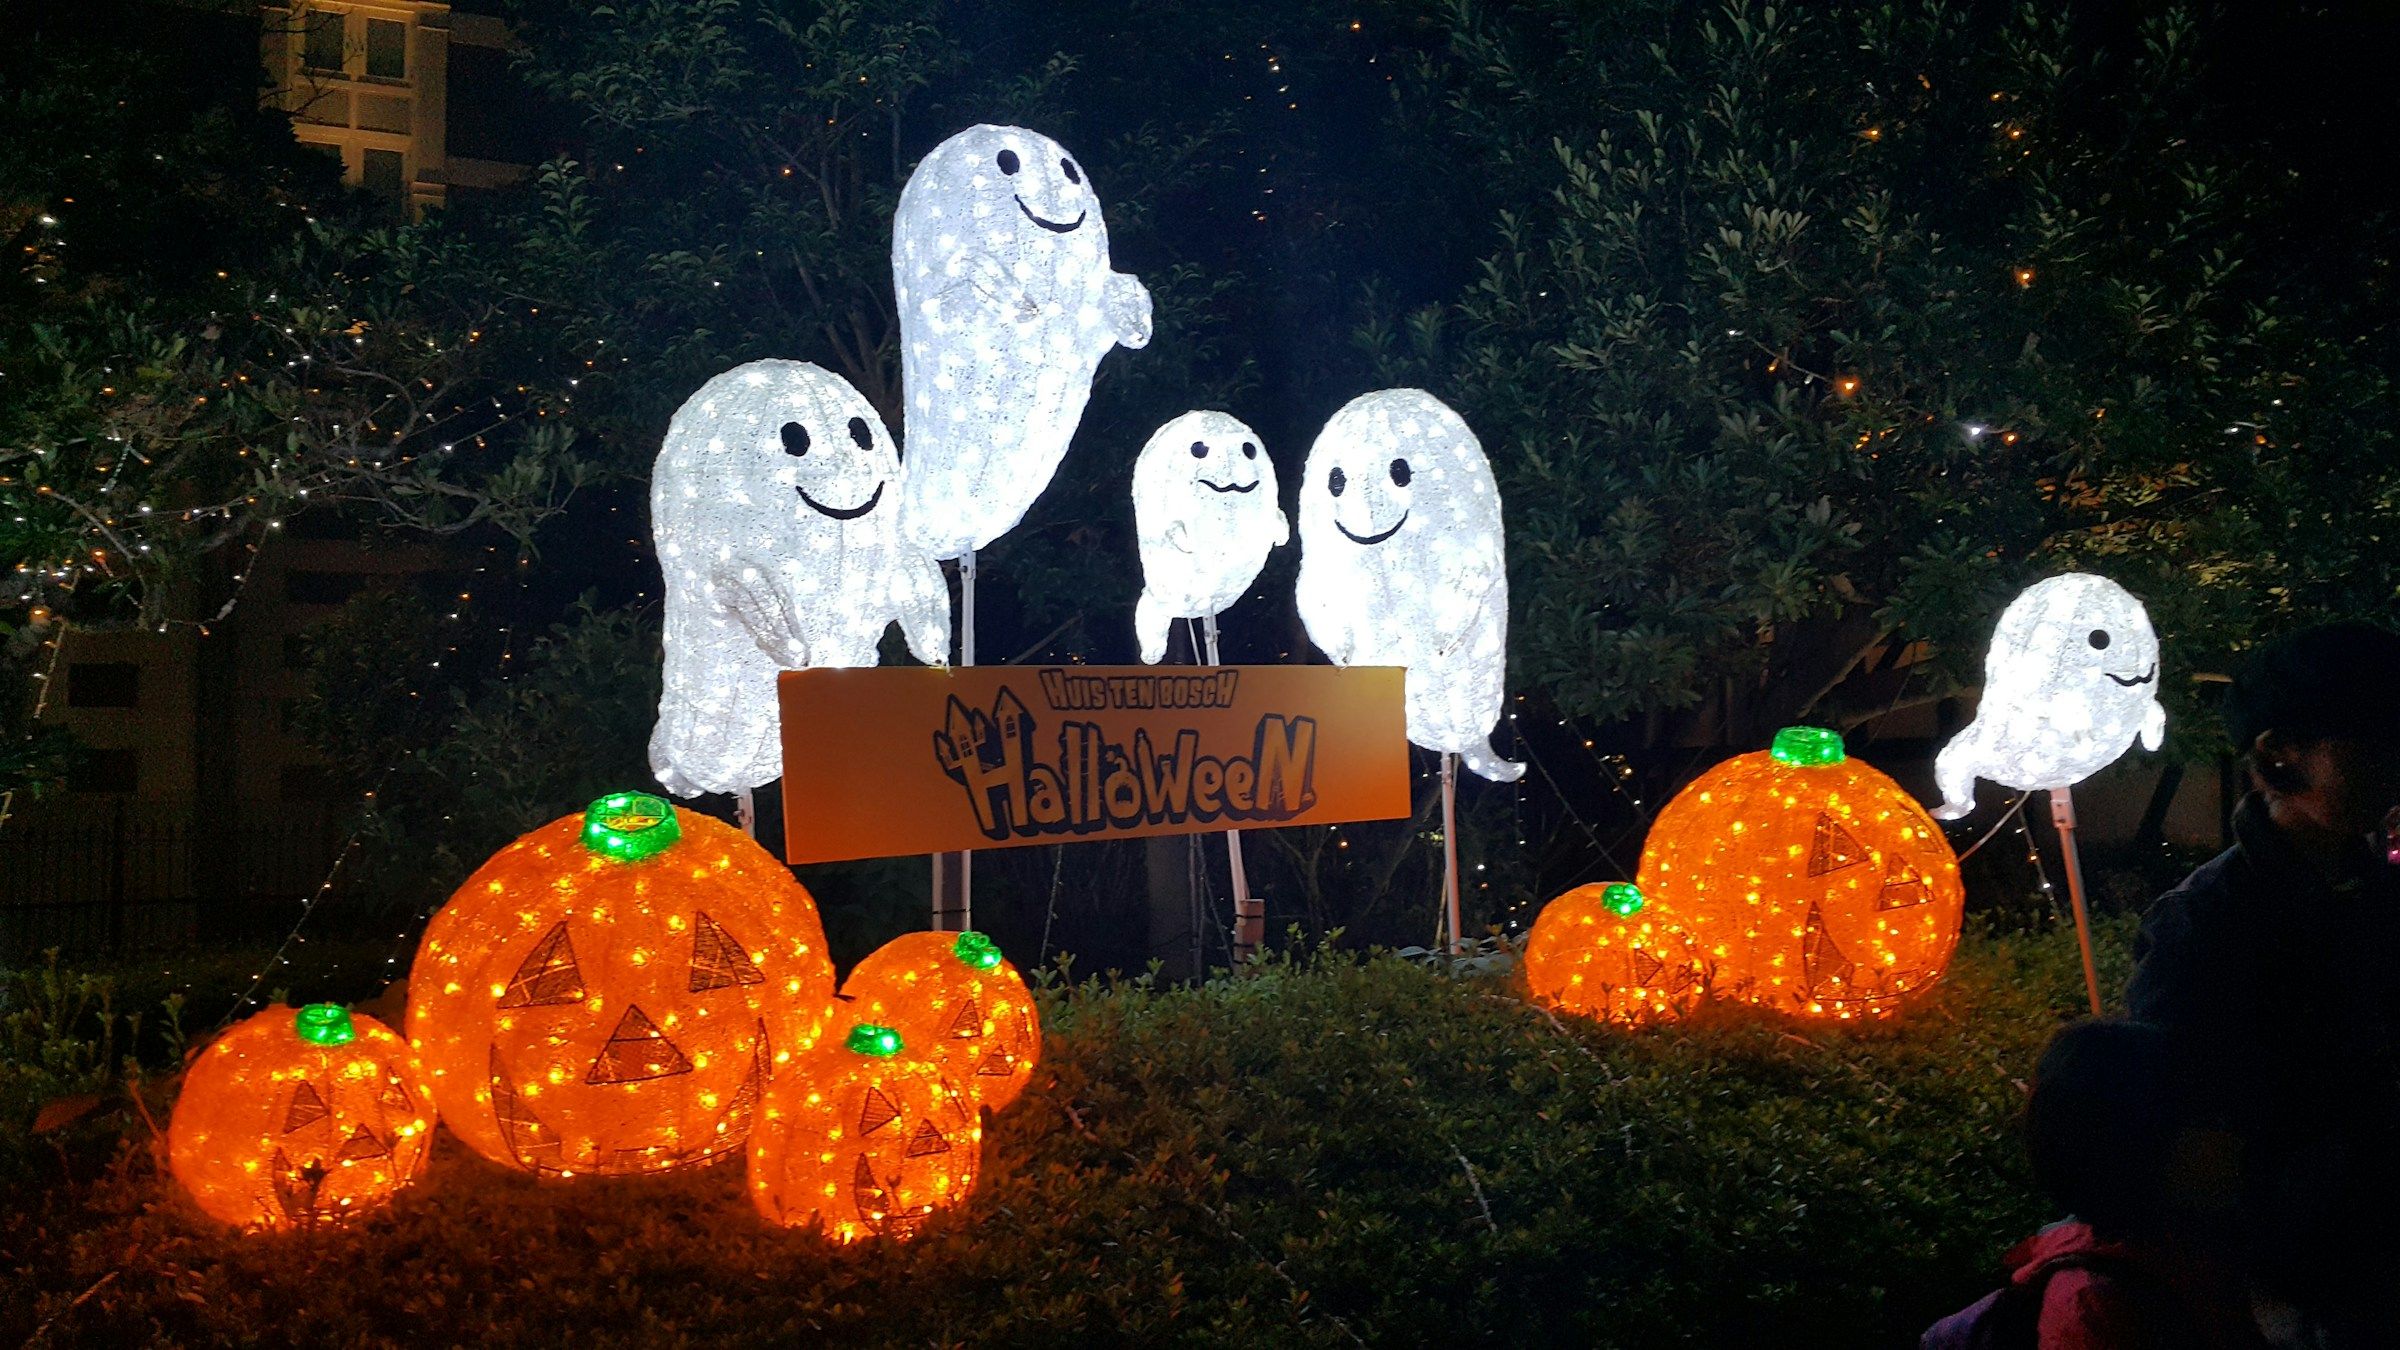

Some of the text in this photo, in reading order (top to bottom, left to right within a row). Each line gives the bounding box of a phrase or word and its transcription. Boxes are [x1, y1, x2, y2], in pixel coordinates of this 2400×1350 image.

[1039, 668, 1238, 710] HUIS TEN BOSCH
